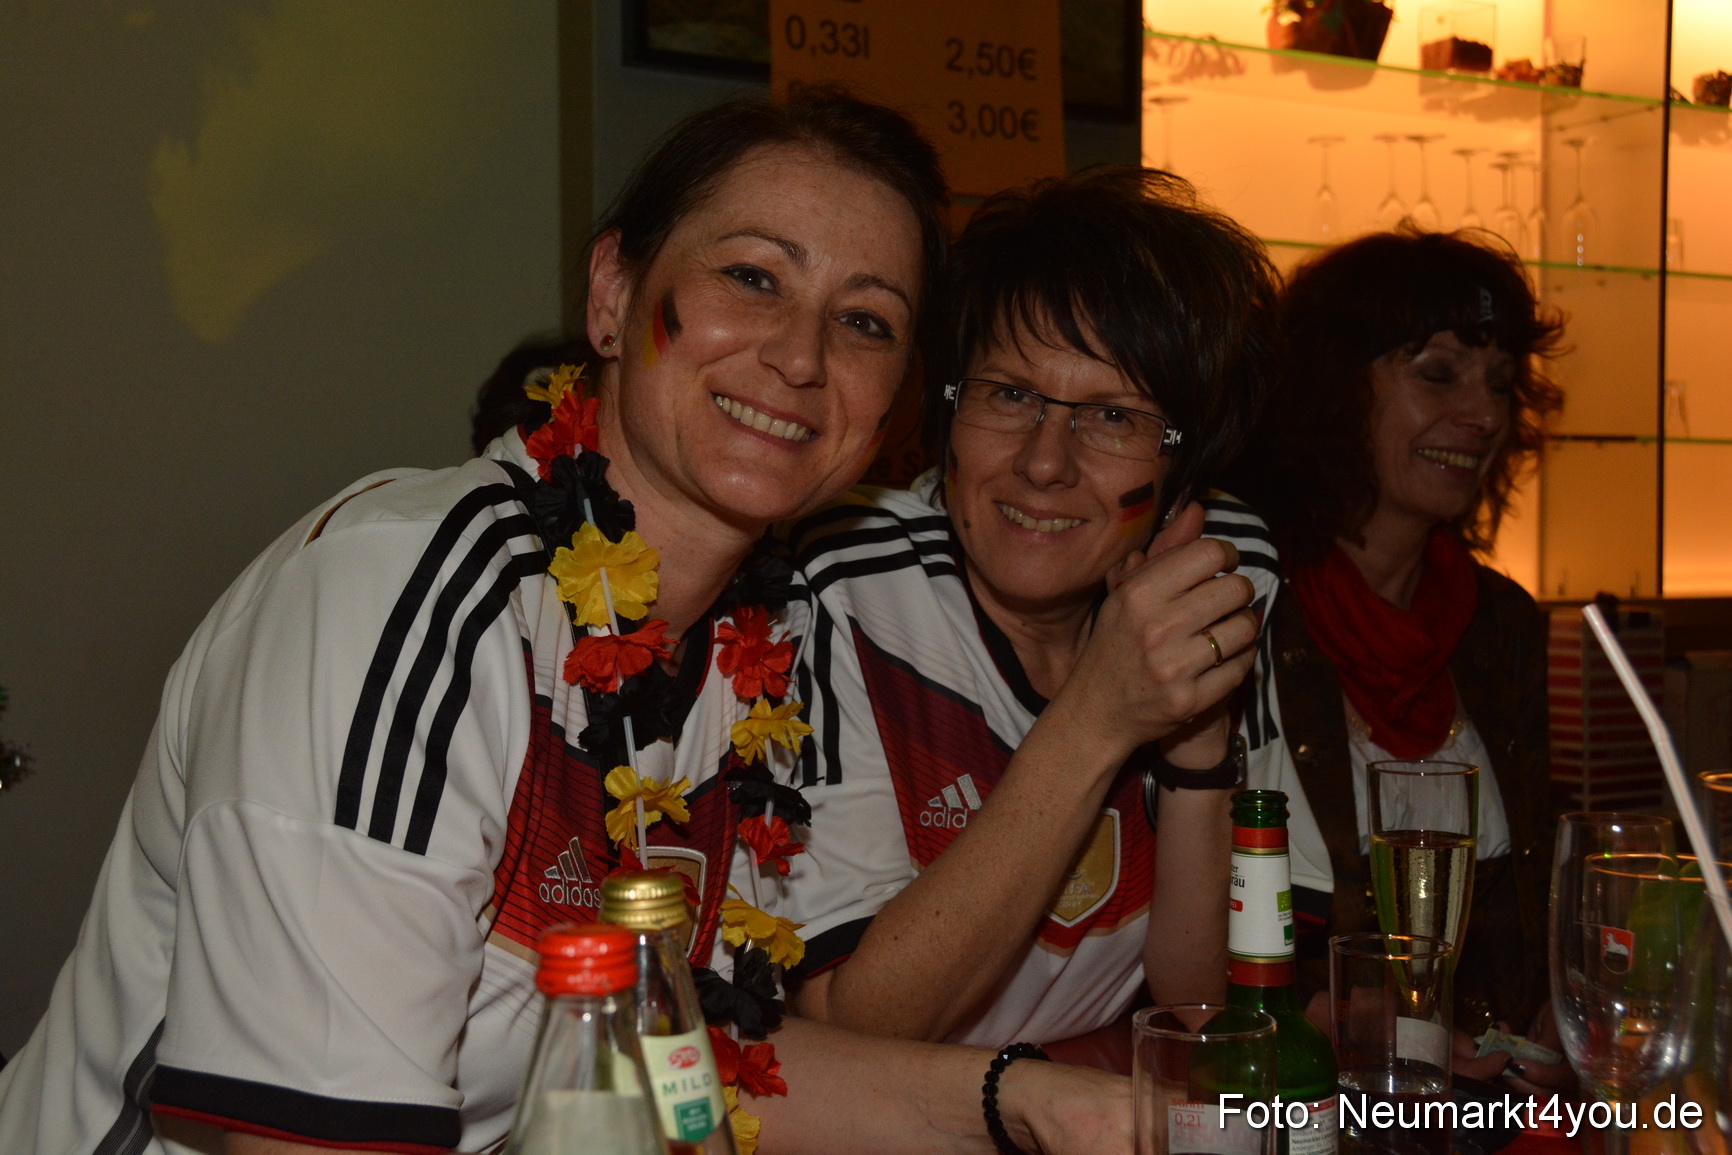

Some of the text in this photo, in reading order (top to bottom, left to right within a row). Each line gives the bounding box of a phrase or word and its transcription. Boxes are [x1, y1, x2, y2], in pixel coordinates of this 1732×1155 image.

[785, 14, 1037, 82] 0,33l 2,50€
[947, 101, 1039, 142] 3,00€
[919, 806, 968, 829] adid
[538, 878, 601, 909] adidas
[662, 1072, 713, 1097] MILD
